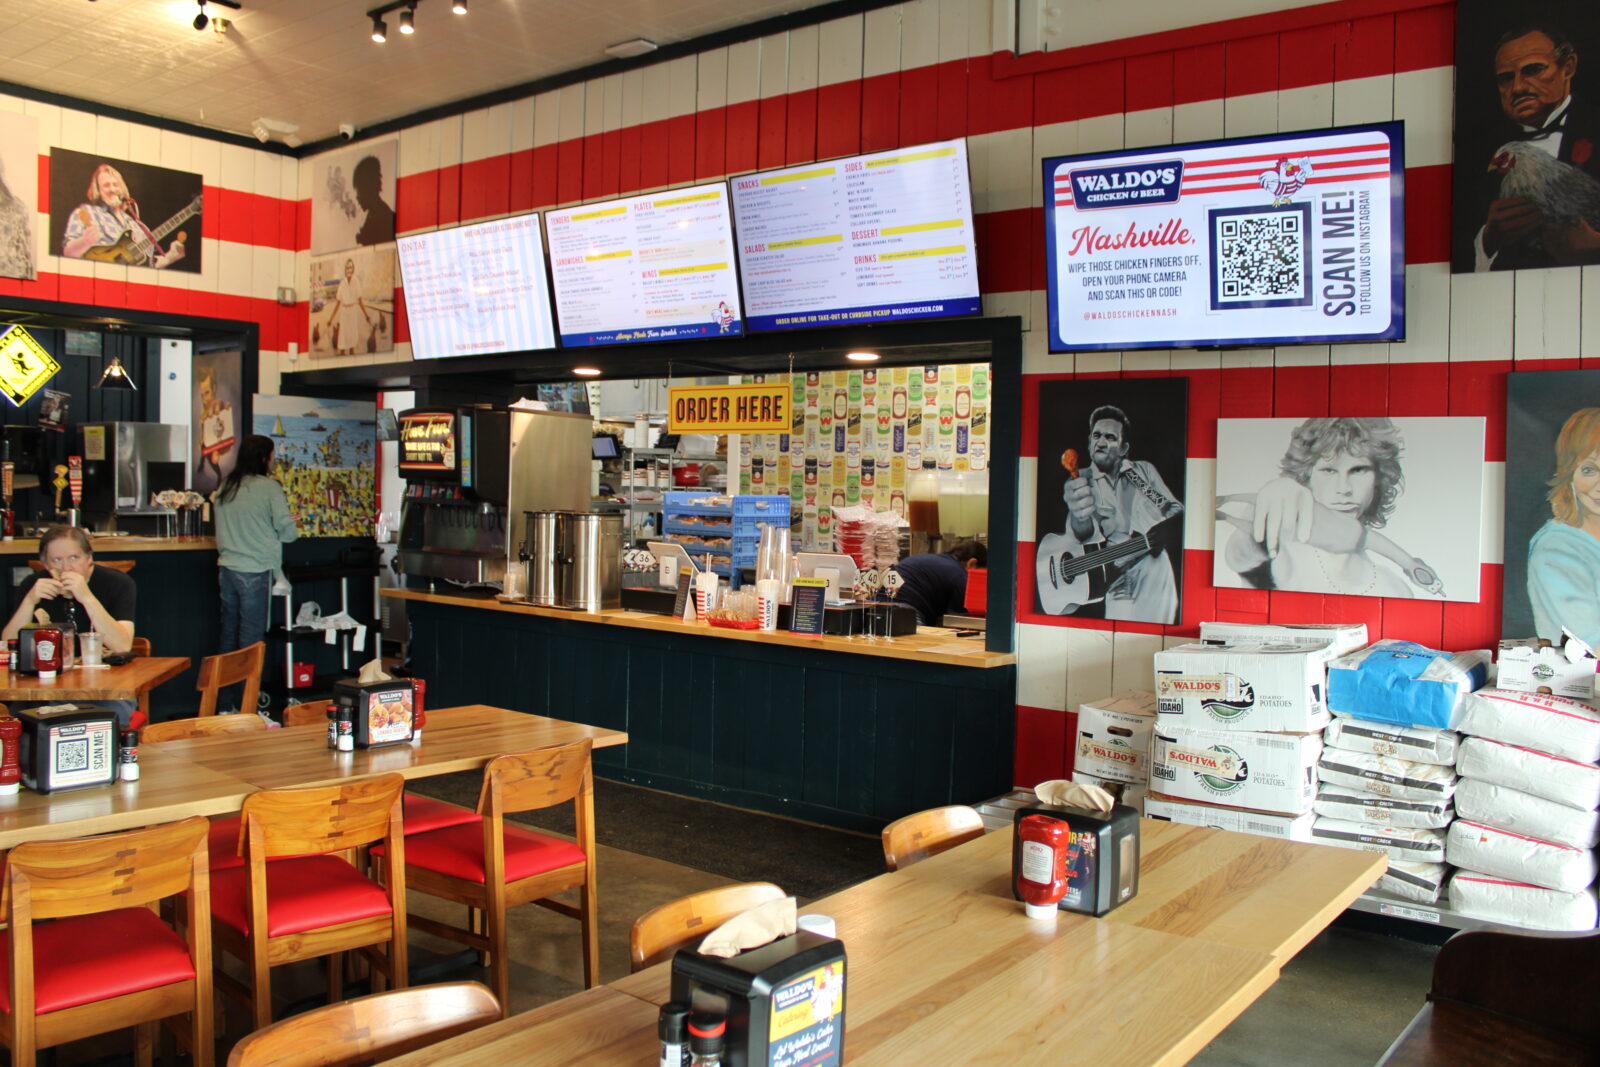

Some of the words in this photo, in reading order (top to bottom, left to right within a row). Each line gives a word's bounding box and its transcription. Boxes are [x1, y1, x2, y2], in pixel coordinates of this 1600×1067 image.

[844, 162, 863, 173] SIDES
[737, 179, 759, 190] SNACKS
[1077, 168, 1175, 192] WALDO'S
[1087, 191, 1129, 202] CHICKEN
[1140, 189, 1165, 198] BEER
[1322, 191, 1355, 239] ME!
[1359, 190, 1371, 240] INSTAGRAM
[851, 229, 878, 240] DESSERT
[1068, 217, 1196, 256] Nashville,
[745, 243, 765, 254] SALADS
[1360, 242, 1370, 253] ON
[854, 254, 877, 264] DRINKS
[1068, 262, 1086, 273] WIPE
[1089, 261, 1112, 272] THOSE
[1115, 259, 1148, 270] CHICKEN
[1150, 257, 1182, 268] FINGERS
[1360, 256, 1371, 266] US
[1082, 276, 1102, 287] OPEN
[1104, 275, 1124, 286] YOUR
[1126, 273, 1151, 284] PHONE
[1154, 271, 1187, 283] CAMERA
[1323, 247, 1355, 316] SCAN
[1360, 270, 1371, 302] FOLLOW
[1088, 291, 1103, 301] AND
[1105, 290, 1125, 300] SCAN
[1128, 288, 1144, 299] THIS
[1159, 286, 1182, 297] CODE!
[818, 313, 840, 321] TAKE-OUT
[892, 305, 944, 316] WALDOSCHICKEN.COM
[1084, 308, 1177, 320] @WALDOSCHICKENNASH
[1360, 305, 1371, 315] TO
[675, 397, 730, 423] ORDER
[736, 395, 783, 422] HERE
[640, 554, 650, 563] 36
[888, 575, 896, 585] 15
[1173, 681, 1221, 691] WALDO'S
[1160, 703, 1181, 711] IDAHO
[1206, 709, 1223, 723] FRESH
[1224, 710, 1250, 724] PRODUCE
[94, 748, 103, 770] SCAN
[1093, 747, 1136, 763] WALDO'S
[1169, 751, 1217, 767] WALDO'S
[1154, 767, 1174, 779] IDAHO
[1198, 780, 1215, 795] FRESH
[1216, 784, 1243, 797] PRODUCE
[1253, 777, 1285, 787] POTATOES
[775, 980, 814, 1003] WALDO'S
